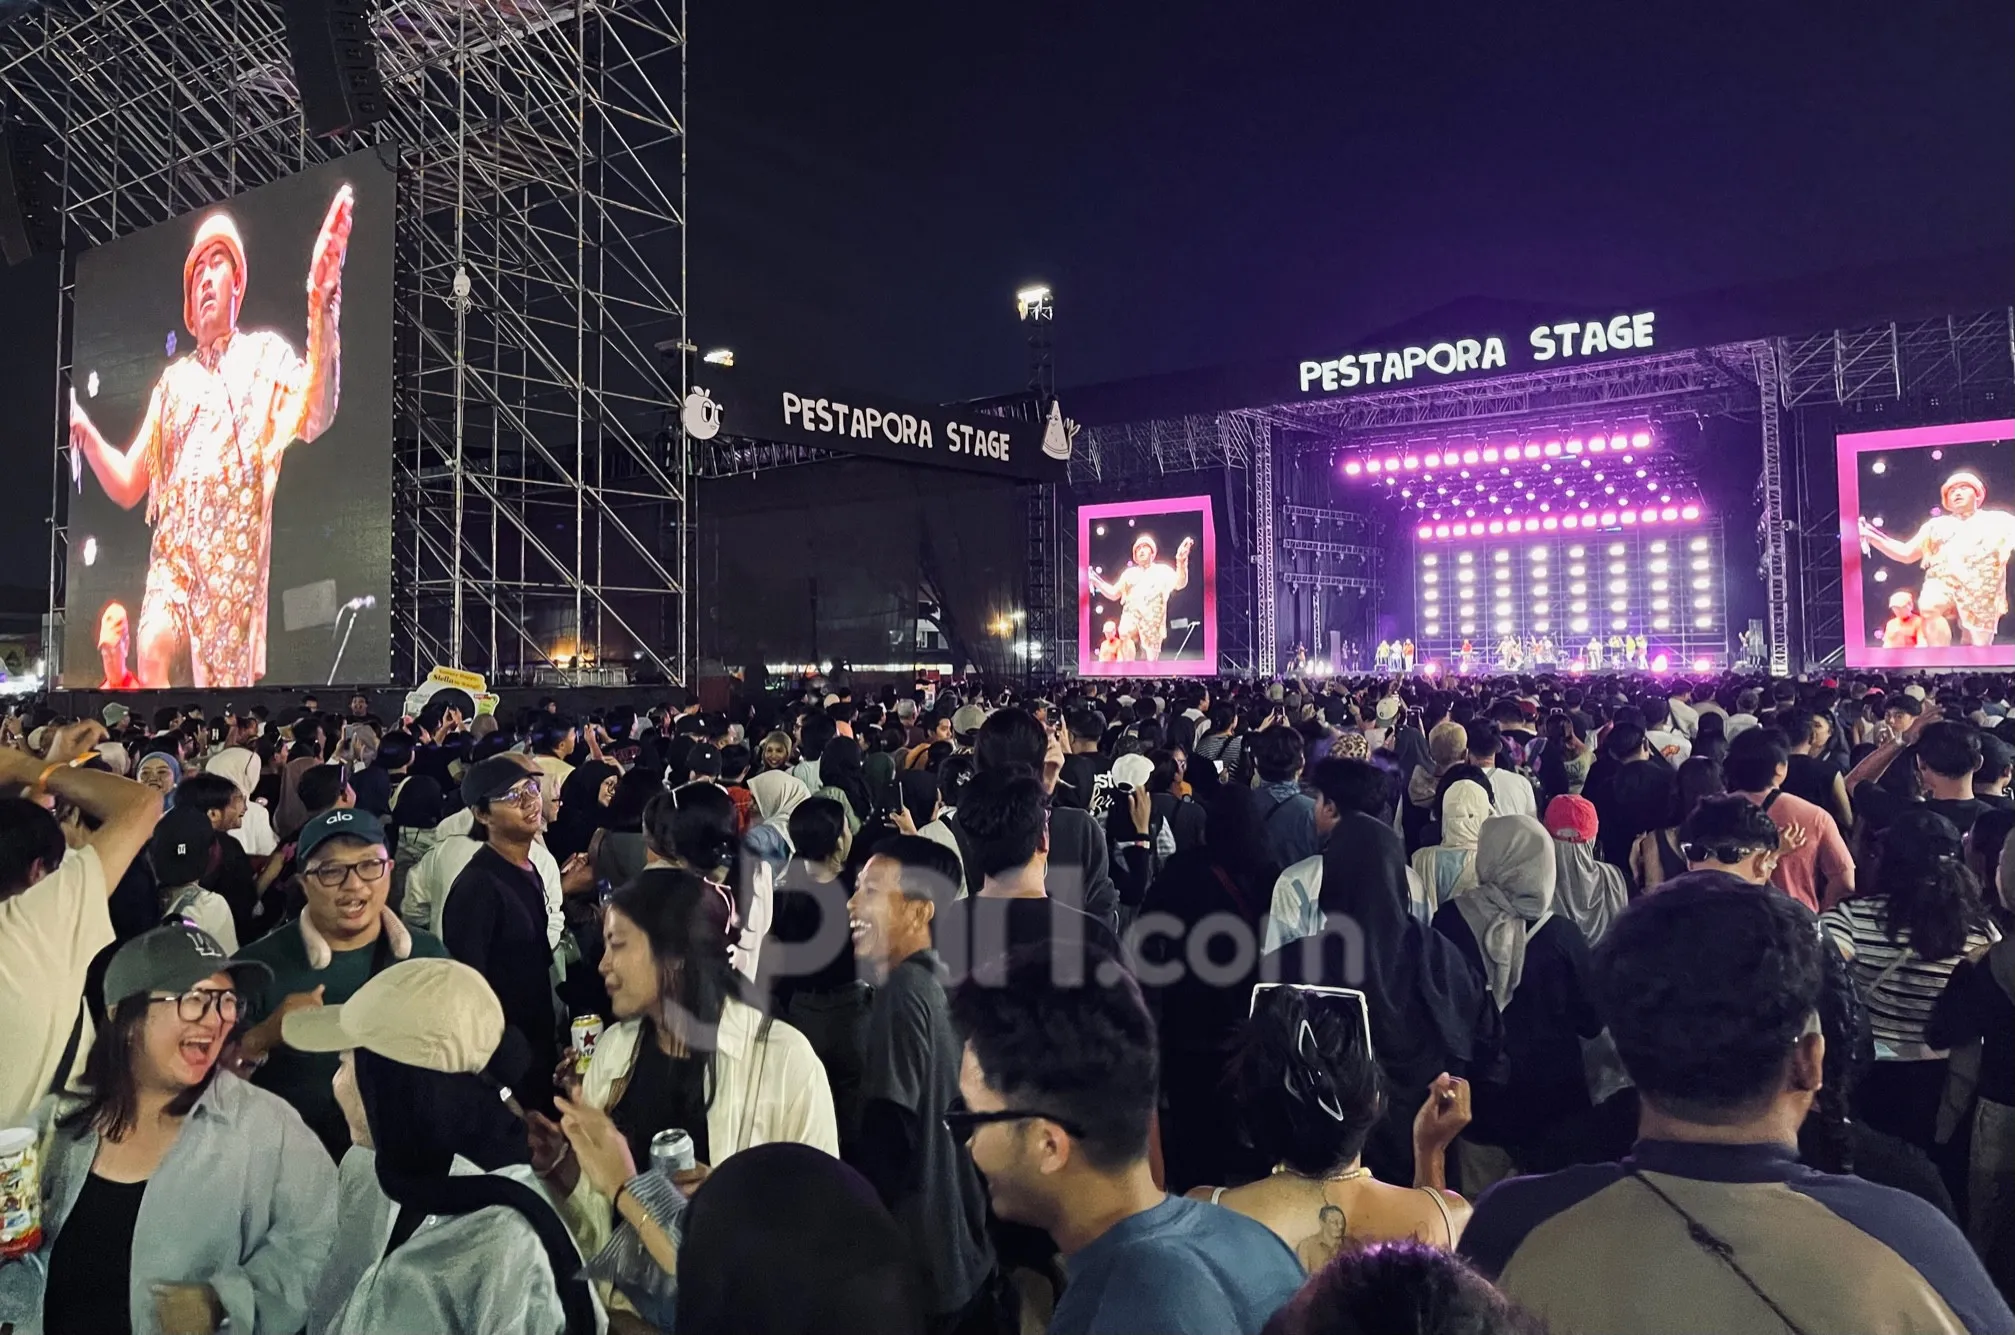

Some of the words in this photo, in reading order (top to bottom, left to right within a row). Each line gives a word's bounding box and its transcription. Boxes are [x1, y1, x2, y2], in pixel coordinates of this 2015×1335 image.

[1299, 337, 1506, 392] PESTAPORA
[1530, 312, 1655, 362] STAGE
[782, 392, 933, 448] PESTAPORA
[947, 422, 1011, 462] STAGE
[326, 811, 354, 825] alo
